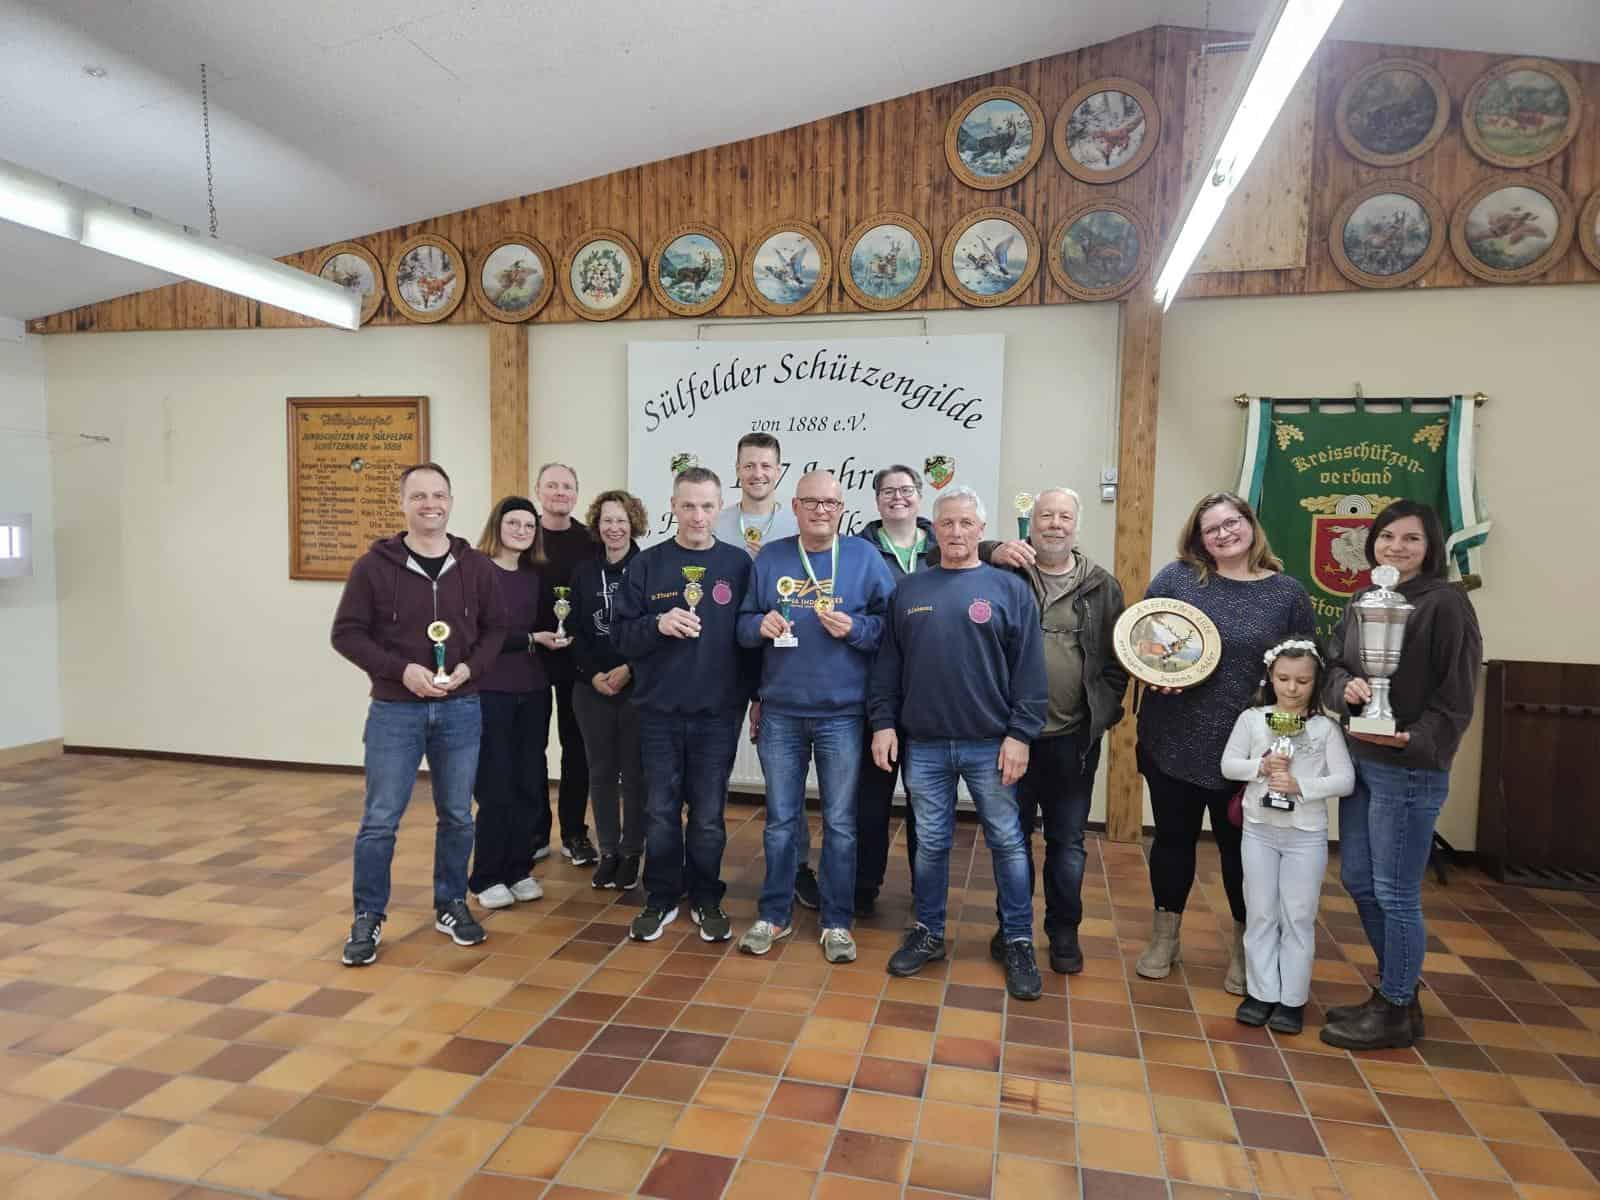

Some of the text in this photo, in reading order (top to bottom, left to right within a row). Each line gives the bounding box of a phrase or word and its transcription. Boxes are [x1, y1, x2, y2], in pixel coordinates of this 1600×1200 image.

[643, 348, 984, 433] Sülfelder Schützengilde
[751, 412, 867, 432] von 1888 e.V.
[1320, 466, 1392, 484] verband
